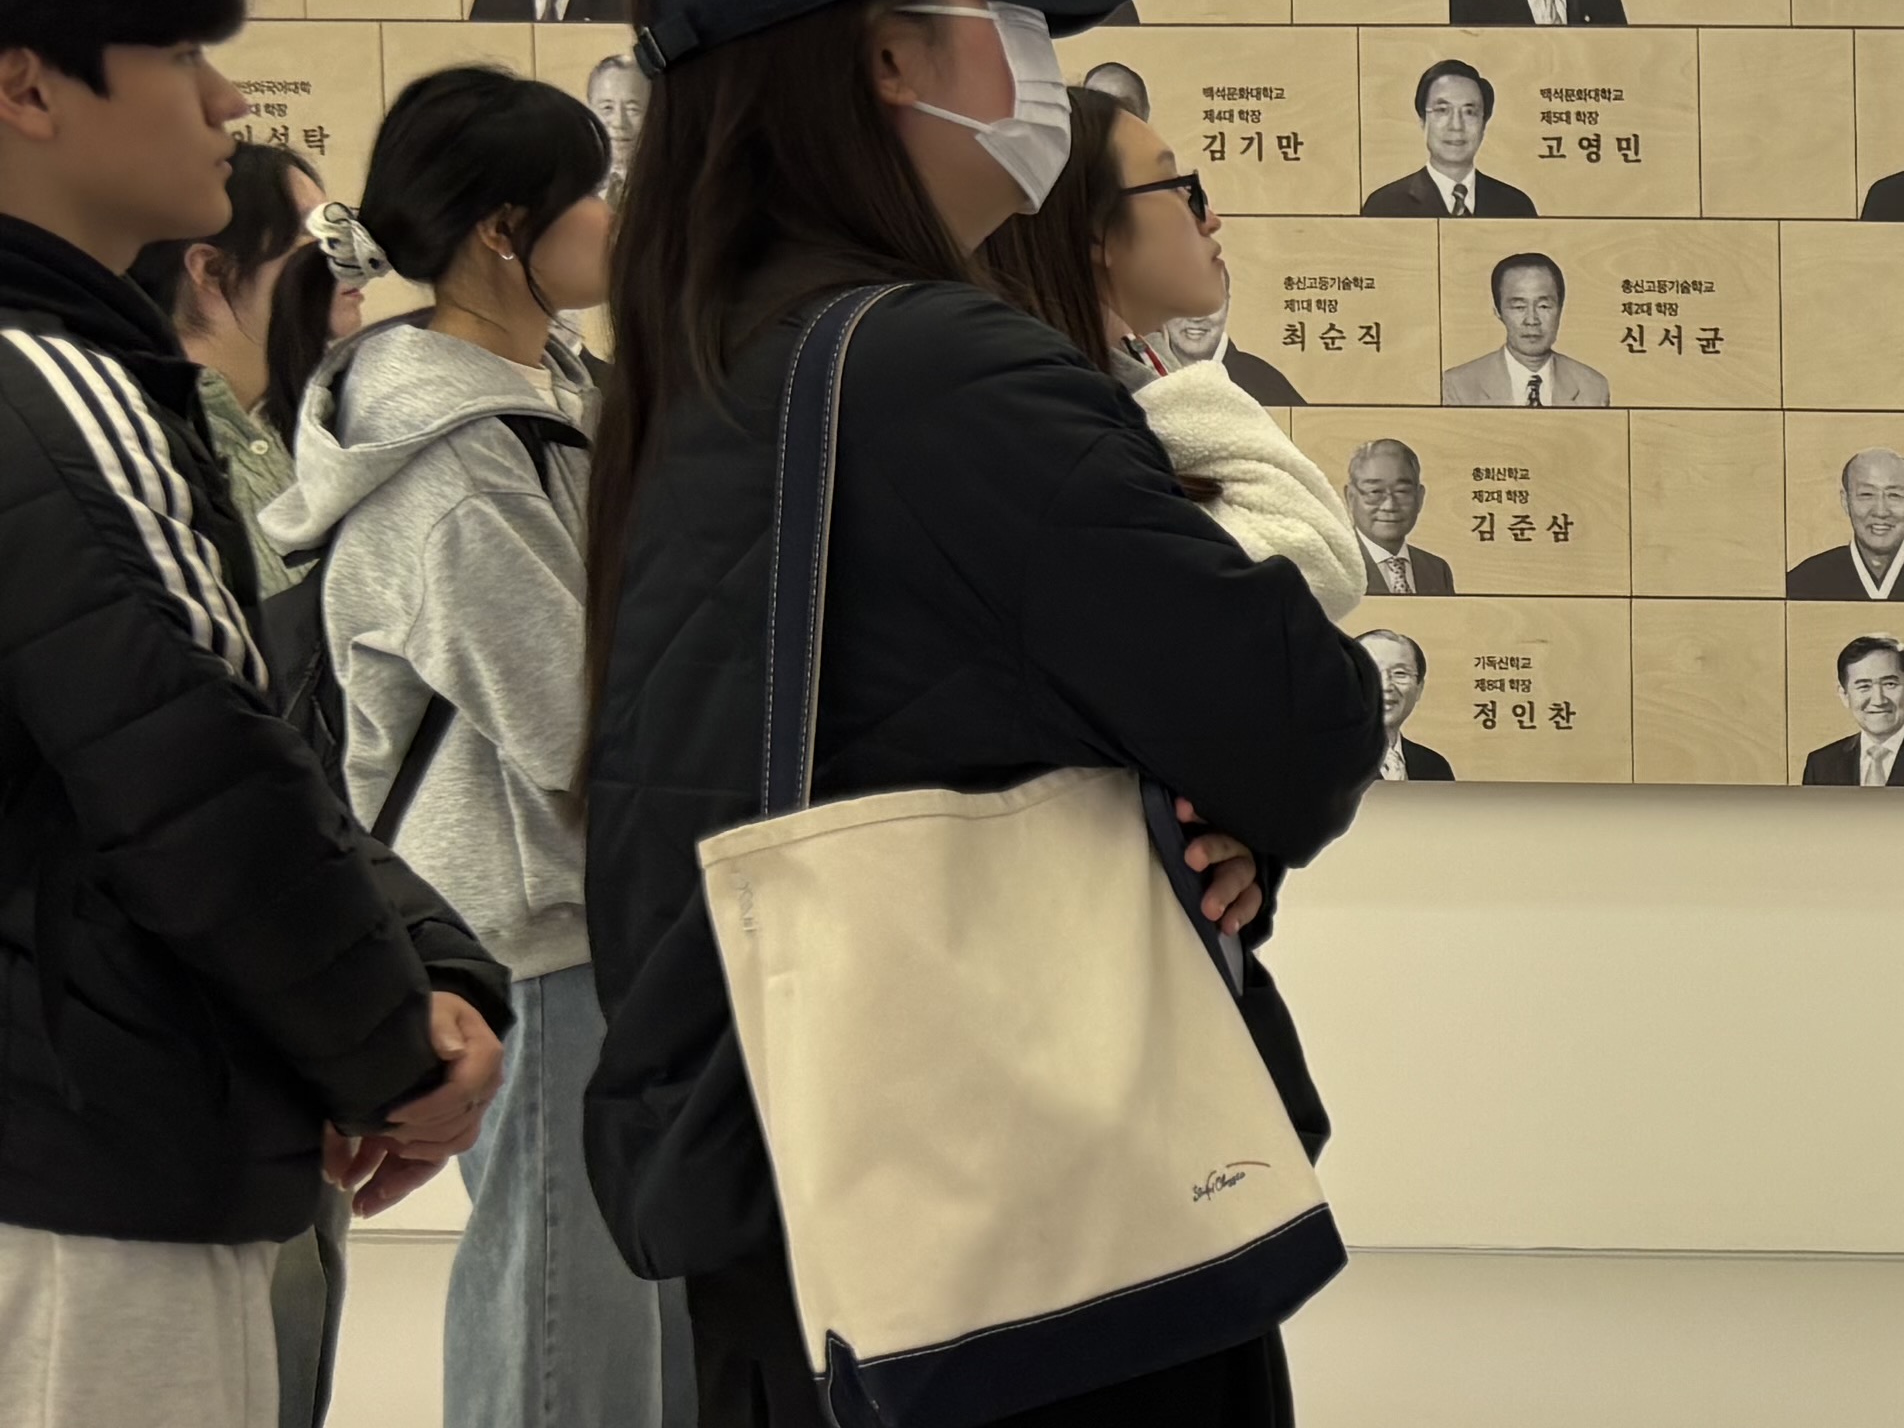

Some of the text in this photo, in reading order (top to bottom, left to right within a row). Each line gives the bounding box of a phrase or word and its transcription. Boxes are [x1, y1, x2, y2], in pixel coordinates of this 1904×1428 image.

[1202, 86, 1286, 101] 백석문화대학교
[1539, 87, 1625, 103] 백석문화대학교
[1202, 108, 1262, 124] 제4대 학장
[1540, 110, 1600, 126] 제5대 학장
[1202, 131, 1305, 163] 김기만
[1537, 132, 1642, 164] 고영민
[1283, 275, 1376, 291] 총신고등기술학교
[1620, 278, 1716, 295] 총신고등기술학교
[1283, 298, 1339, 314] 제1대 학장
[1621, 301, 1679, 317] 제2대 학장
[1281, 321, 1381, 353] 최순직
[1620, 323, 1725, 356] 신서균
[1471, 466, 1531, 482] 총회신학교
[1471, 489, 1530, 505] 제2대 학장
[1471, 511, 1575, 544] 김준삼
[1474, 655, 1533, 671] 기독신학교
[1474, 678, 1533, 693] 제8대 학장
[1473, 699, 1577, 731] 정인찬
